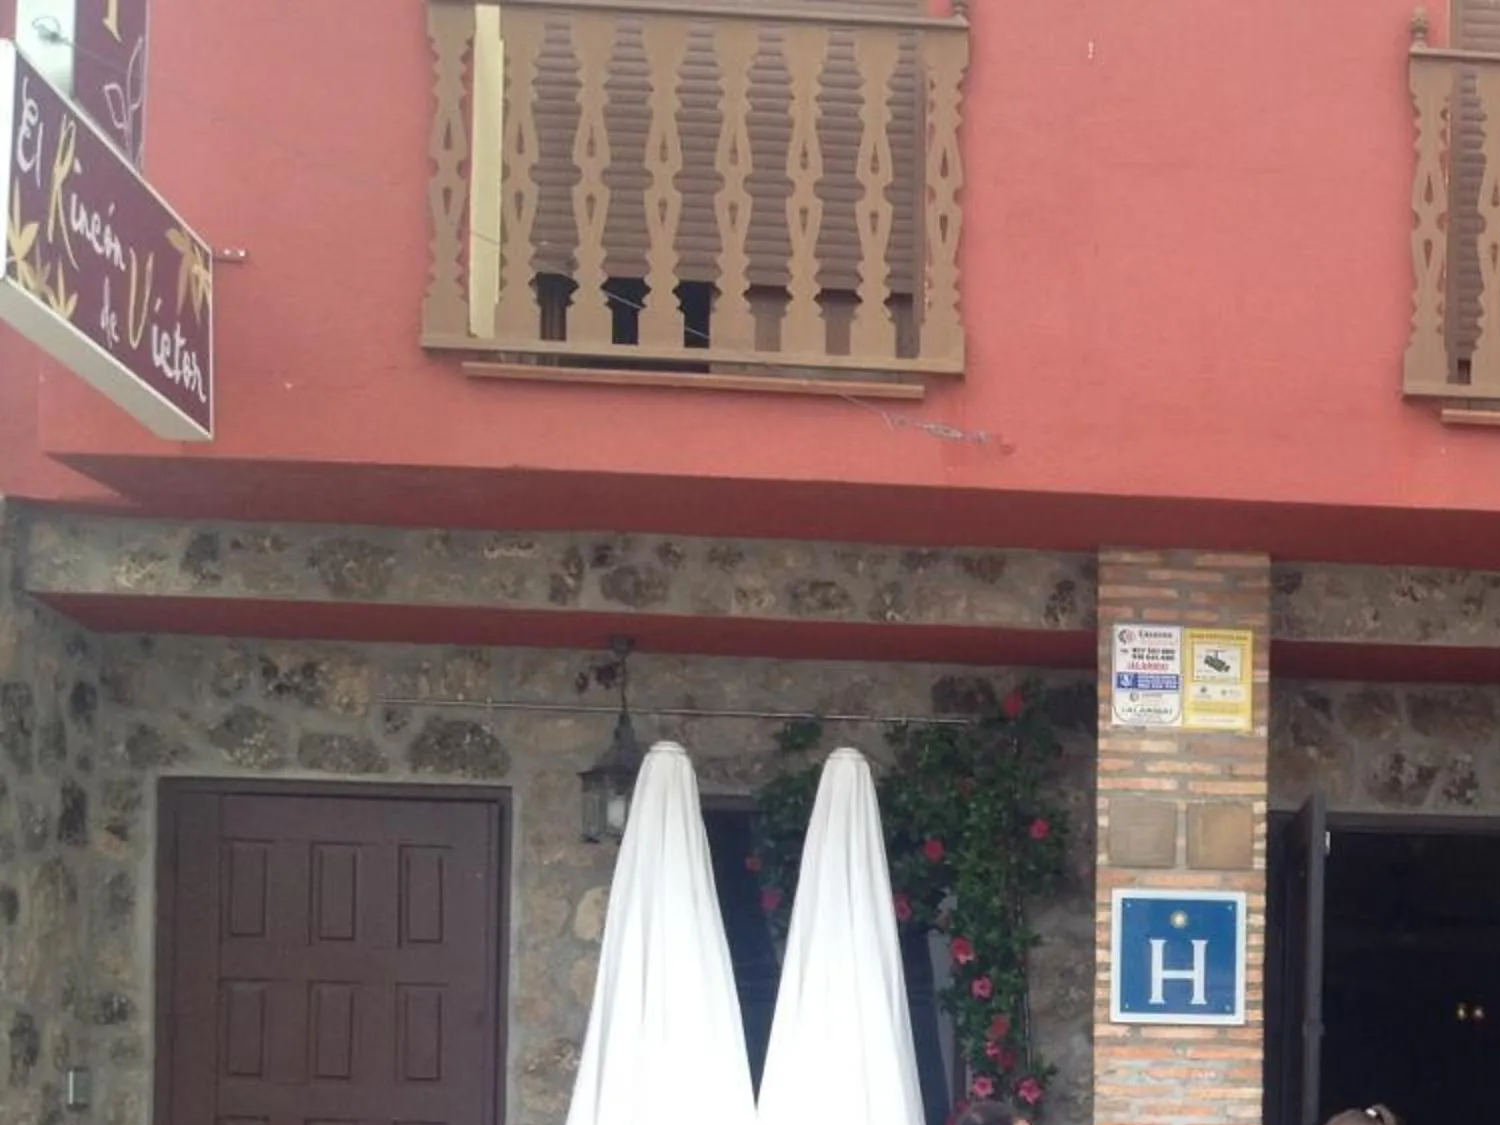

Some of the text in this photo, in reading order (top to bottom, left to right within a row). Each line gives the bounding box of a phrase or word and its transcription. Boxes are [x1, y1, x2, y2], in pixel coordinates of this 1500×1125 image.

[16, 77, 43, 188] El
[100, 277, 121, 348] de
[1149, 939, 1208, 1004] H
